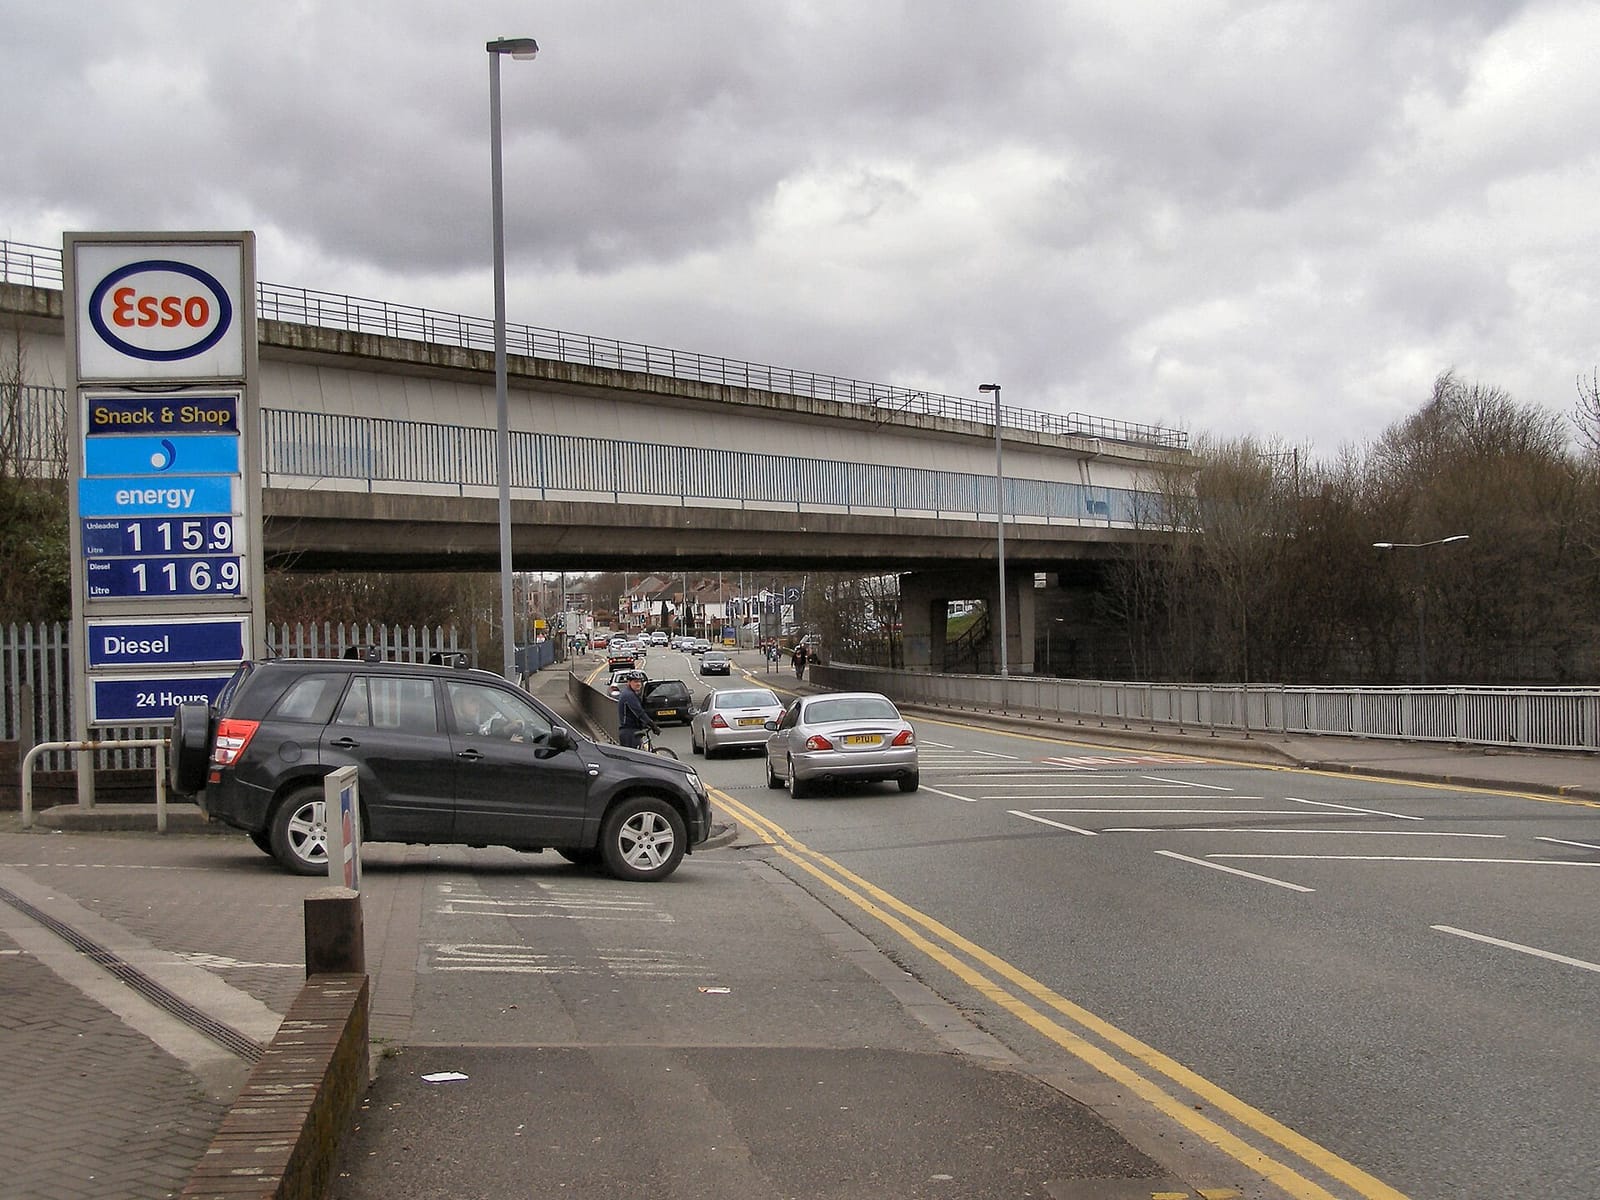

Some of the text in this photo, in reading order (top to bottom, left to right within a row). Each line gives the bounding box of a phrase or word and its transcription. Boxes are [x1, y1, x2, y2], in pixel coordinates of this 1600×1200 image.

[112, 287, 210, 328] Esso
[95, 406, 231, 425] Snack & Shop
[115, 488, 195, 508] energy
[86, 522, 119, 530] Unleaded
[90, 586, 110, 595] Litre
[103, 635, 169, 655] Diesel
[136, 693, 156, 707] 24
